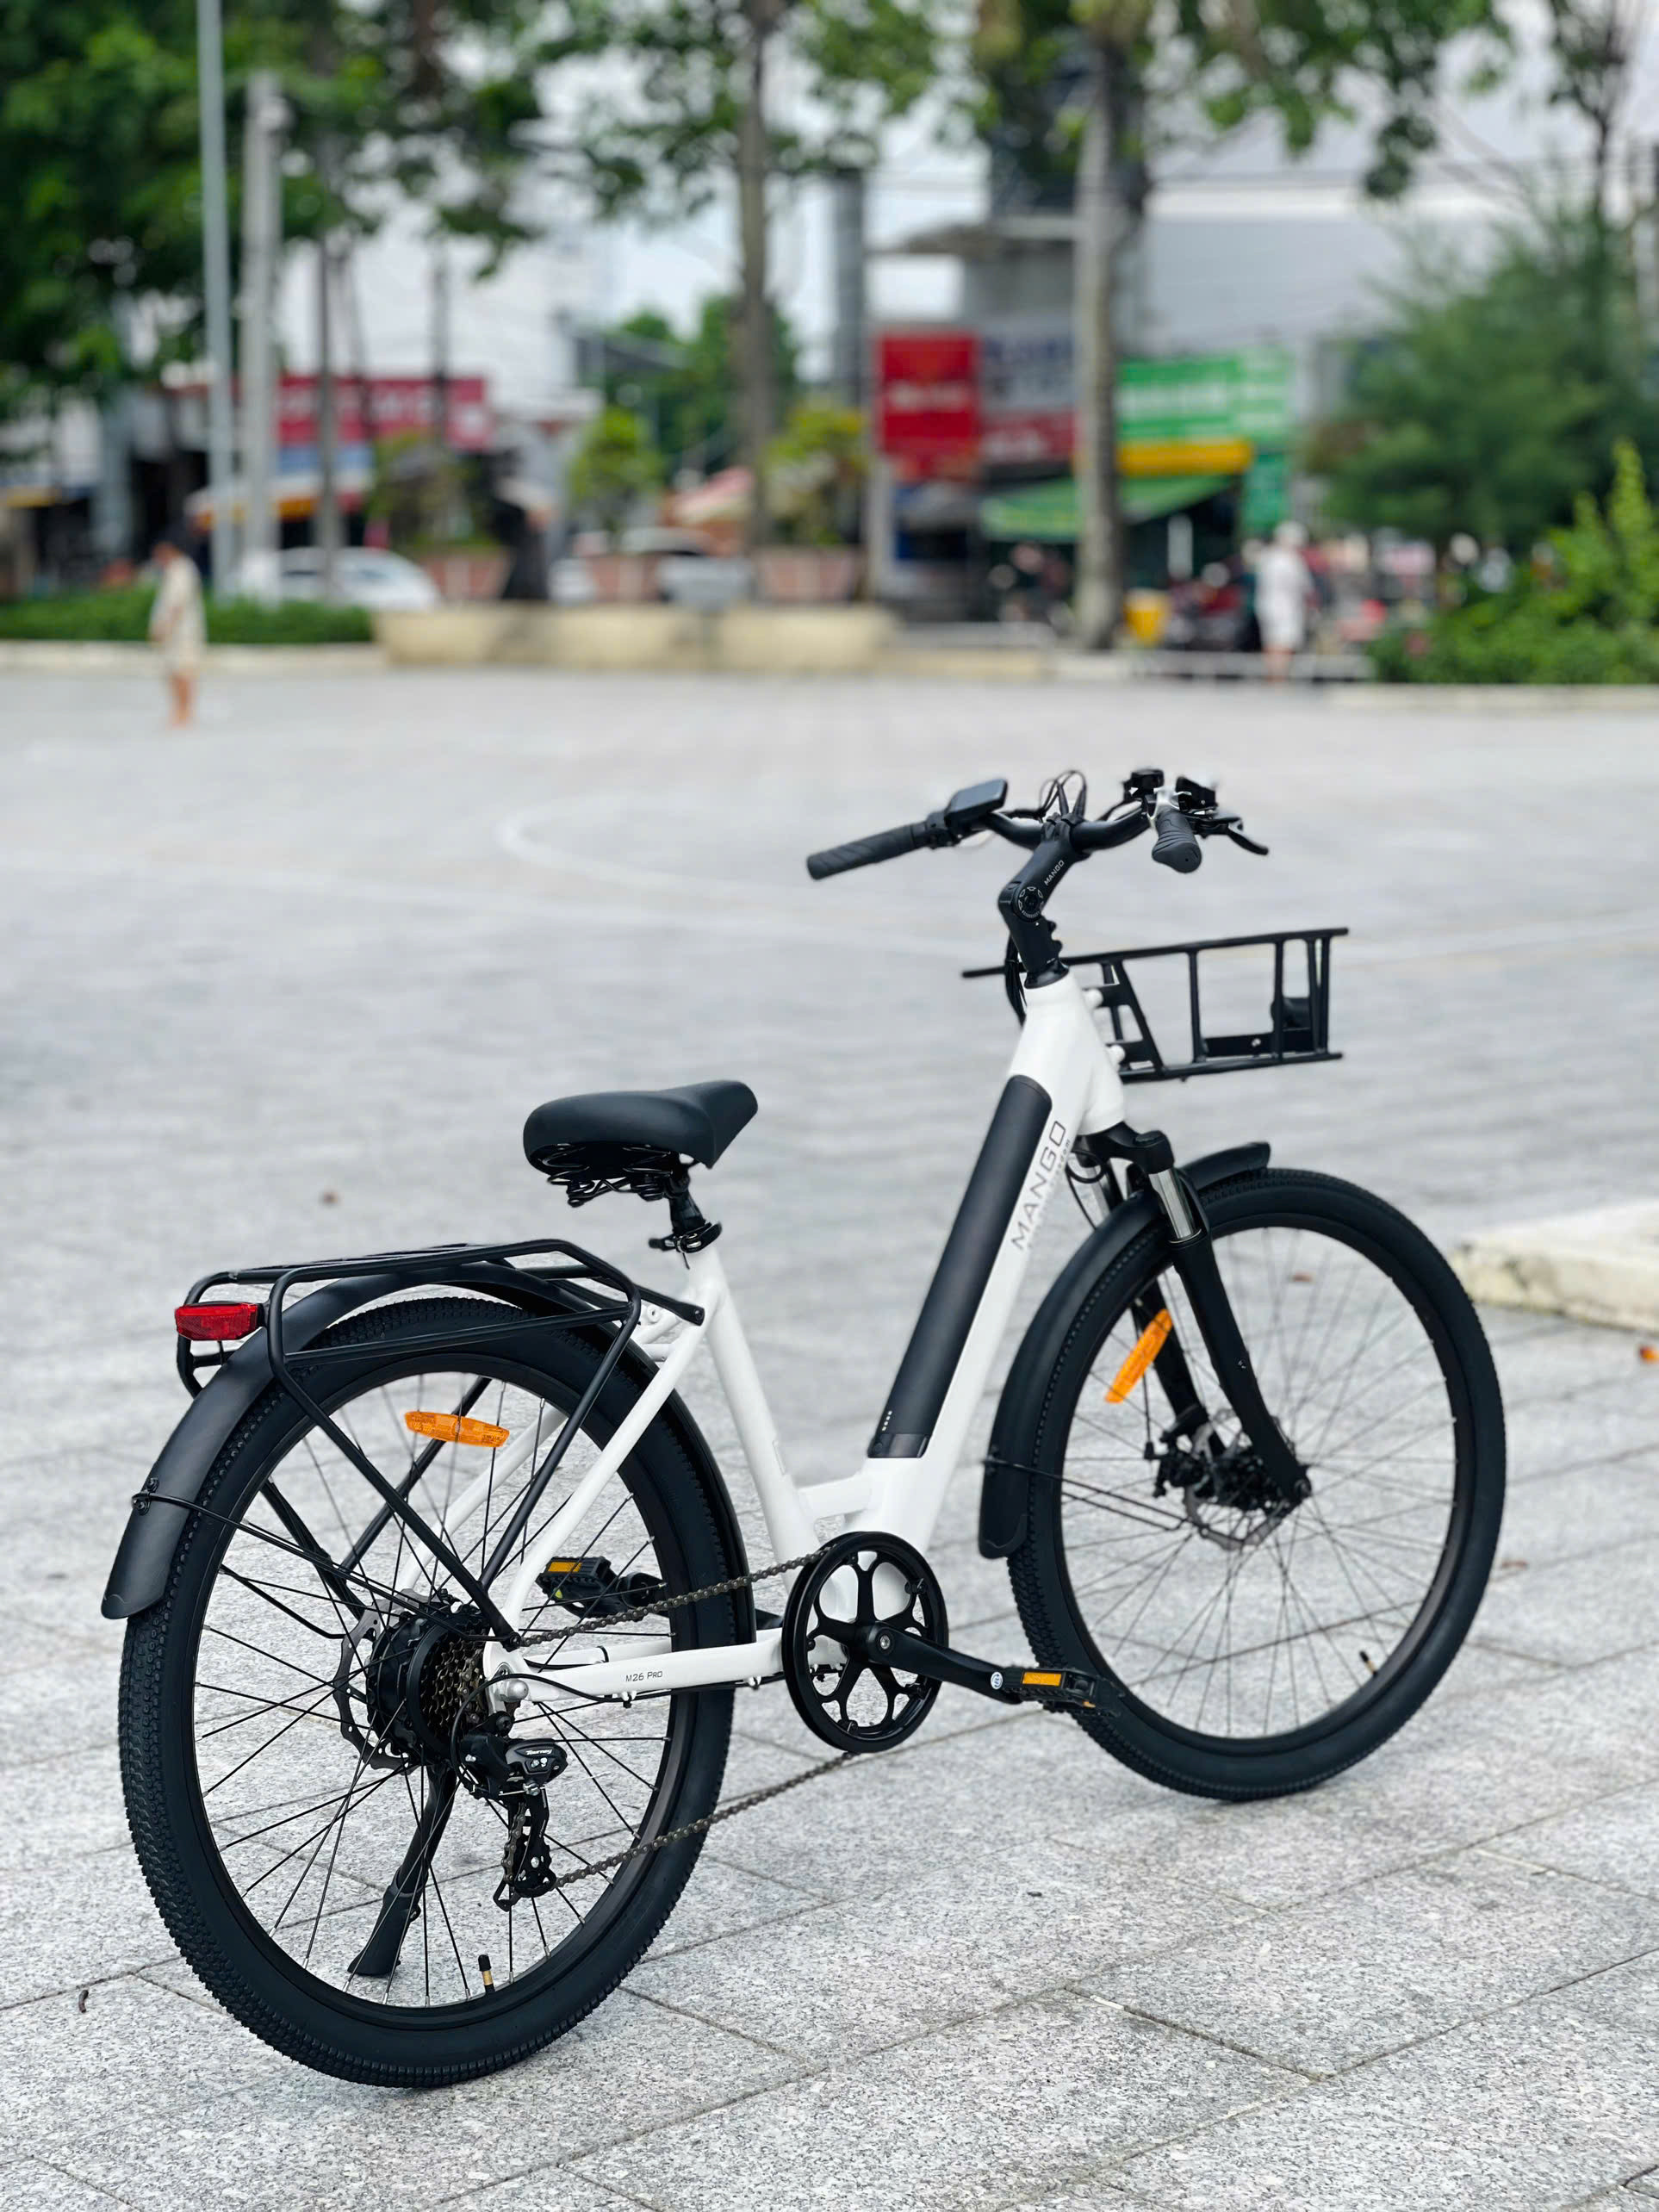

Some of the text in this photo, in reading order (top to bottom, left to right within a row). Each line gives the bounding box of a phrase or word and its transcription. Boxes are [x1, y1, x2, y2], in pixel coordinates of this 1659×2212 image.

[1043, 860, 1065, 886] MANGO
[1010, 1120, 1066, 1252] MANGO
[625, 1670, 663, 1682] M26 PRO
